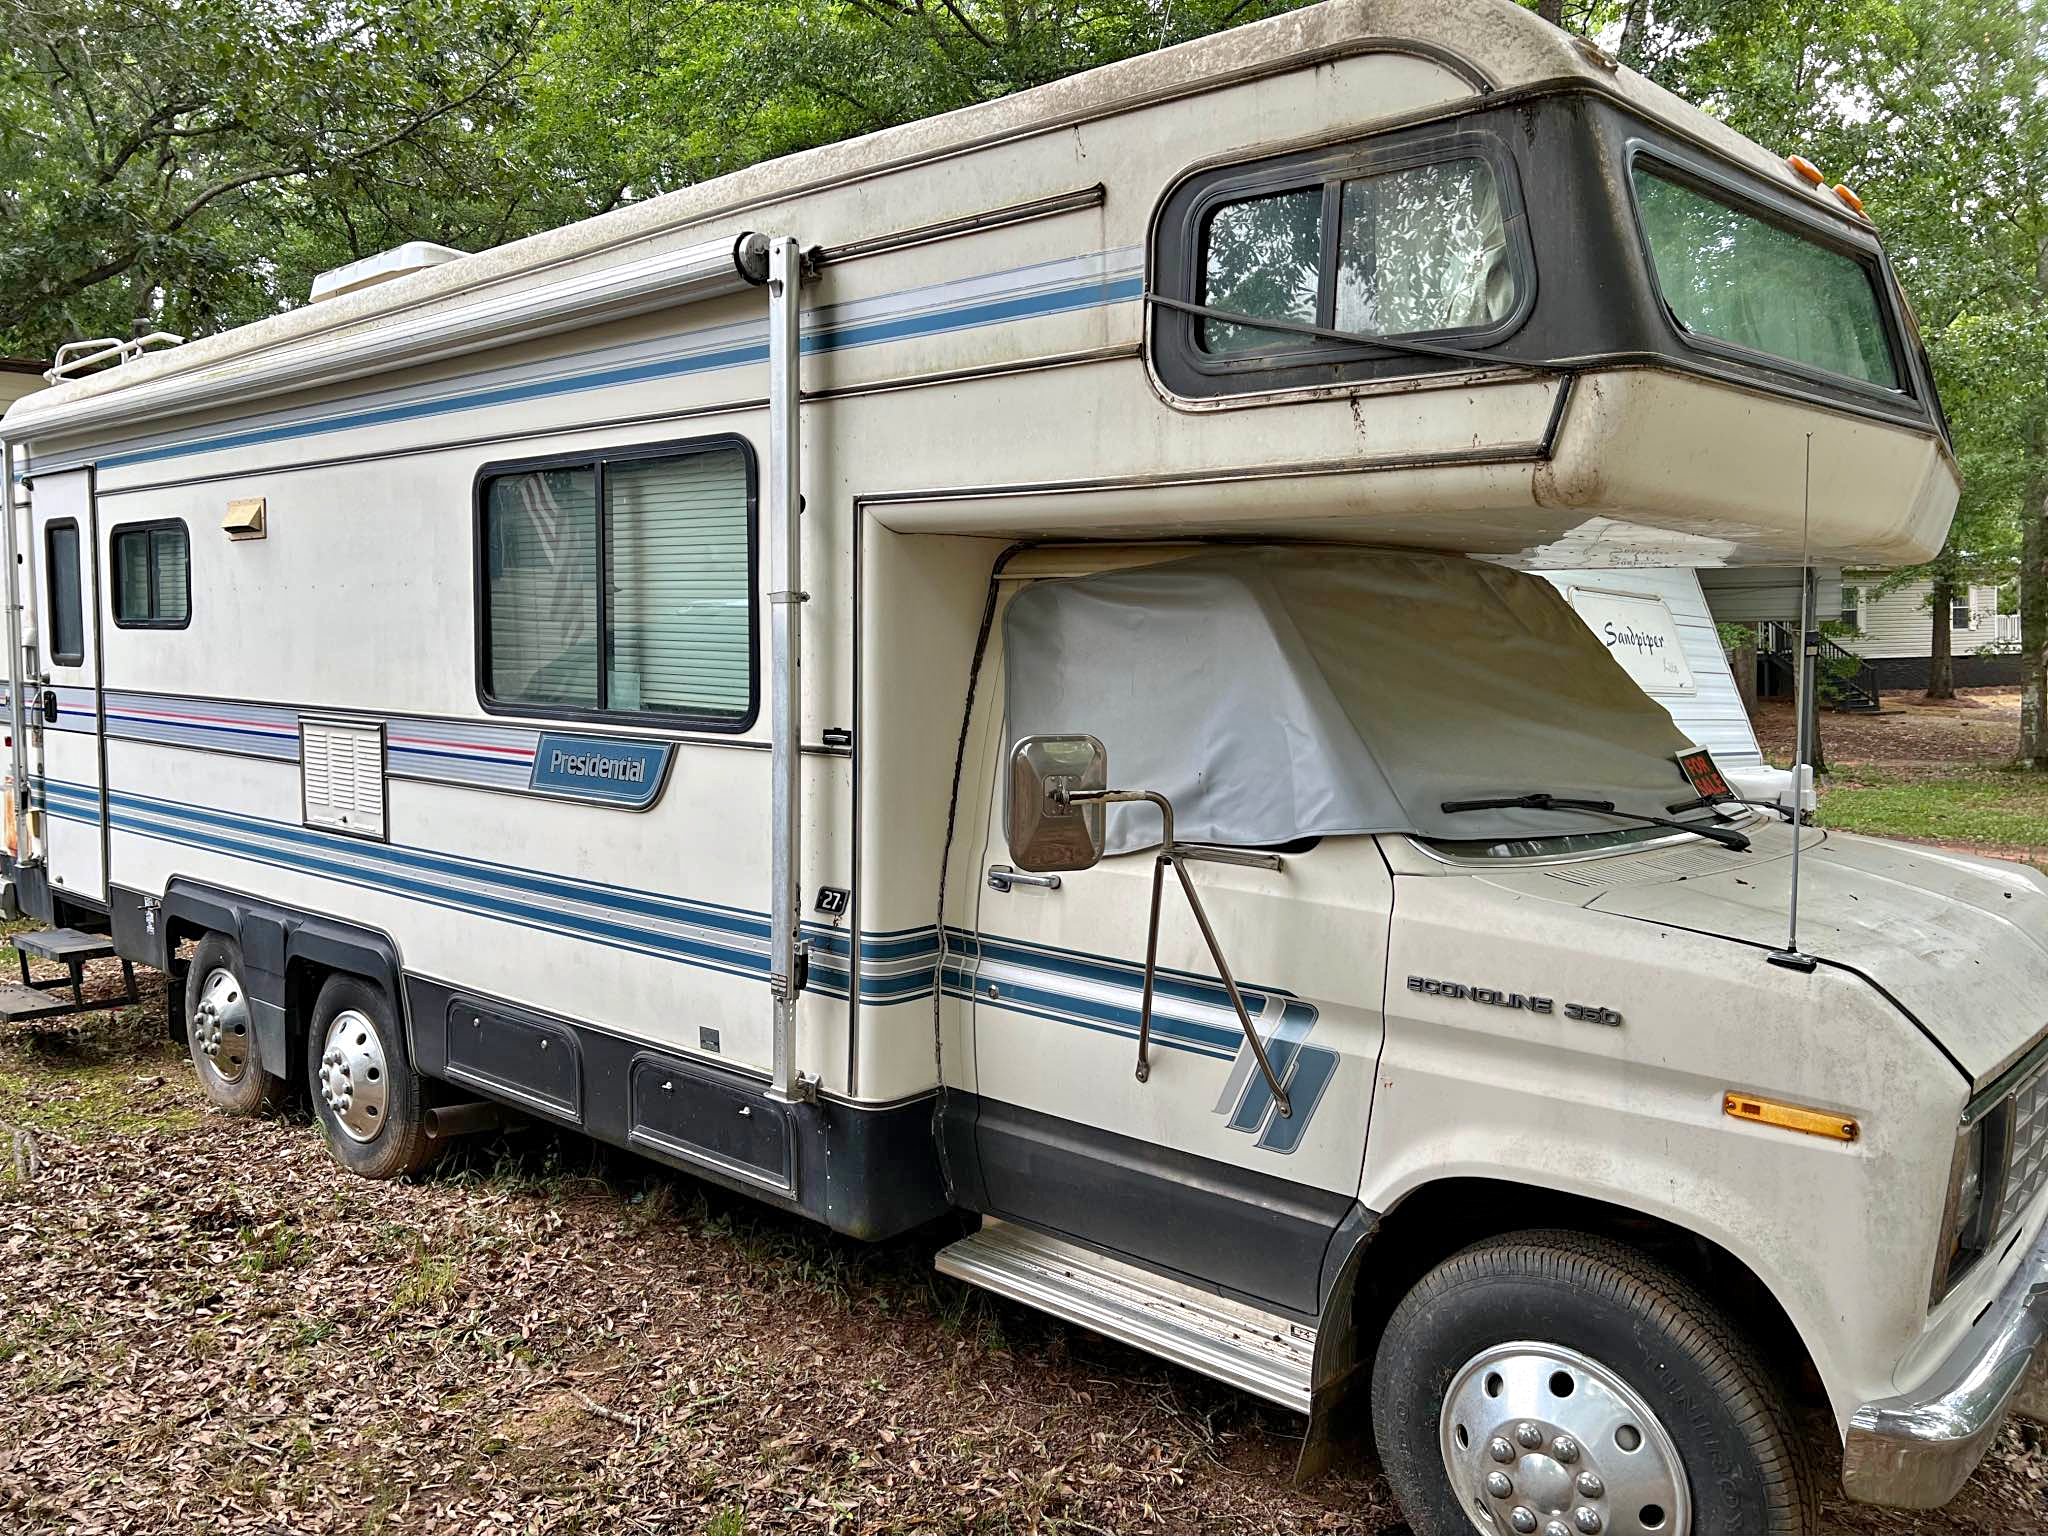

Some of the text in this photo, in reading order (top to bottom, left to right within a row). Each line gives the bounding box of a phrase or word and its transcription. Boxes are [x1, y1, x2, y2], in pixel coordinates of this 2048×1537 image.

[1604, 621, 1665, 655] Sandpiper
[551, 749, 646, 783] Presidential
[822, 890, 841, 910] 27
[1406, 974, 1623, 1027] ECONOLINE 350
